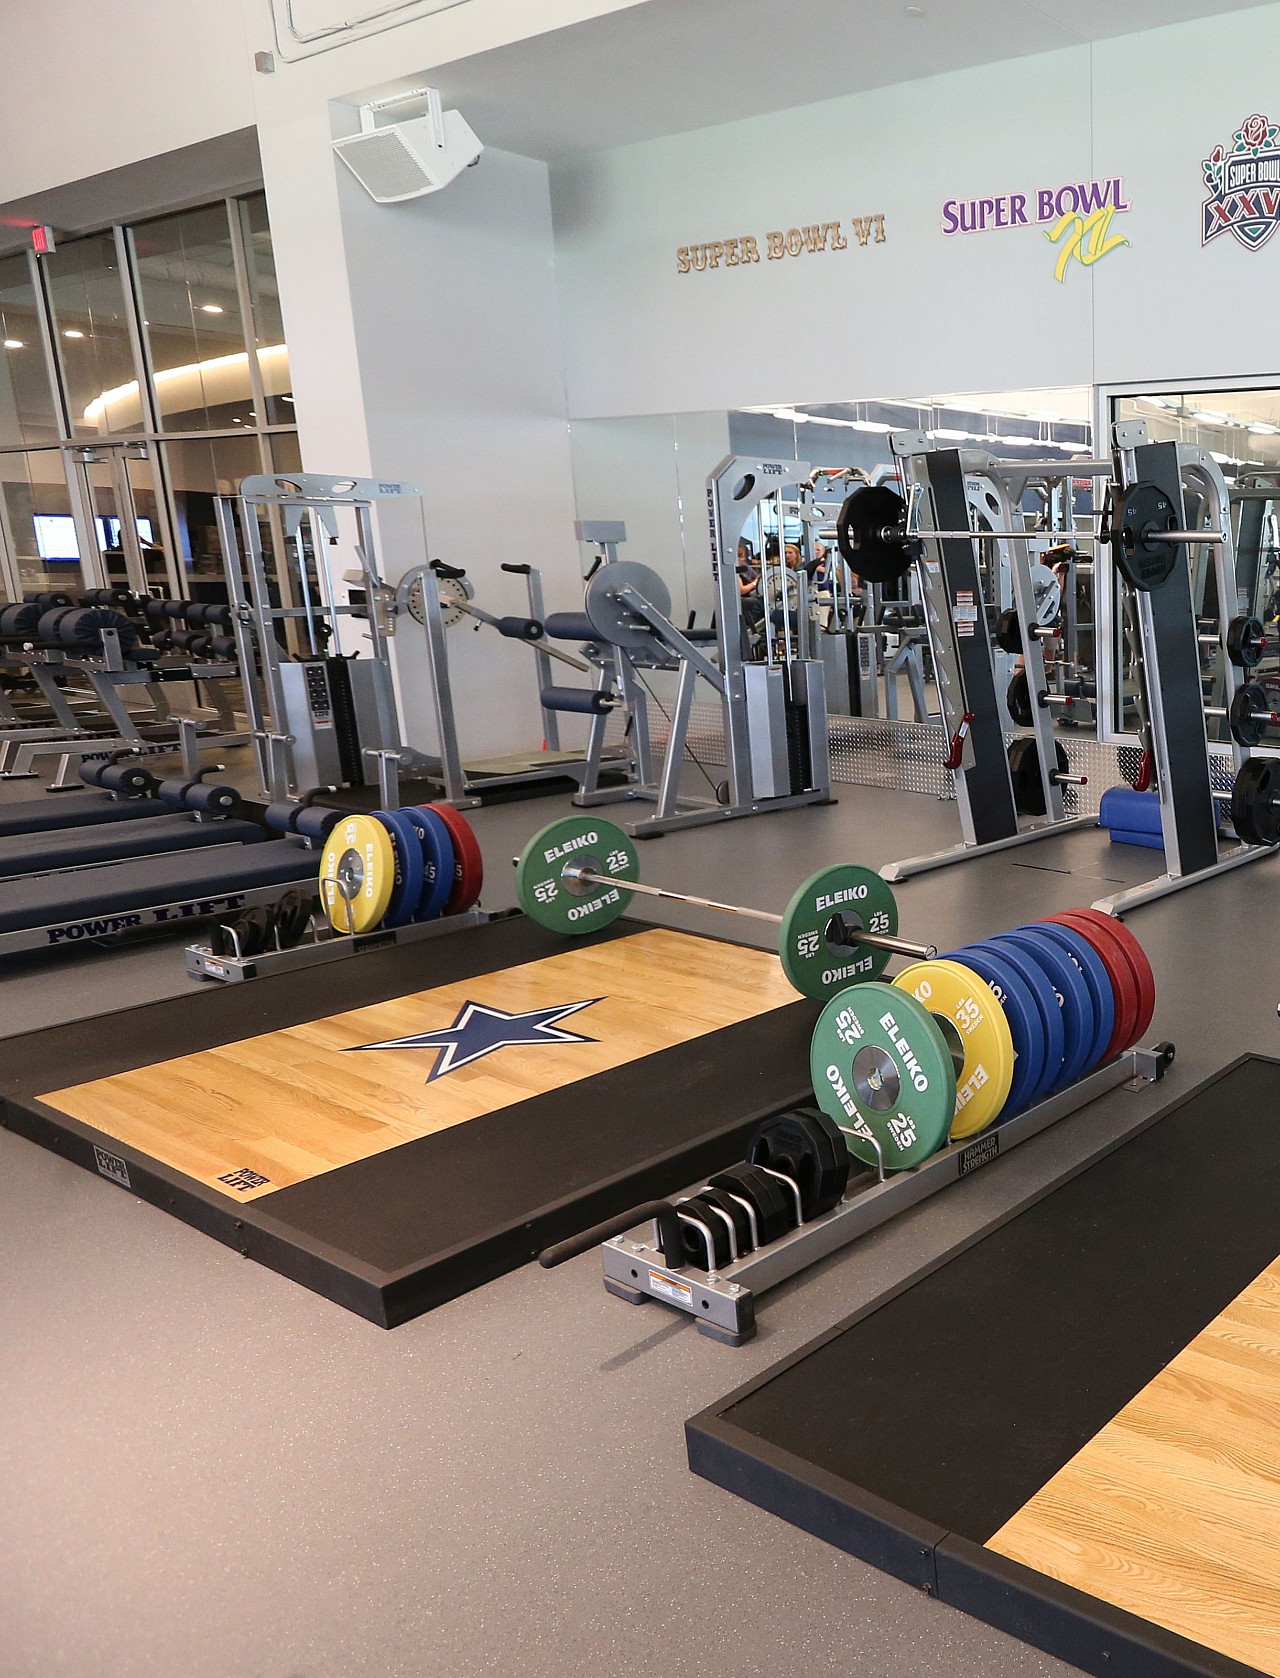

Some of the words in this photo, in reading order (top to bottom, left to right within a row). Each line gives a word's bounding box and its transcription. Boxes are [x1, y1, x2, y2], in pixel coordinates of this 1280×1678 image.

[1230, 163, 1257, 188] SUPER
[942, 193, 1029, 235] SUPER
[1036, 177, 1131, 222] BOWL
[677, 235, 760, 274] SUPER
[766, 221, 847, 260] BOWL
[852, 213, 886, 246] VI
[711, 543, 720, 582] LIFT
[544, 832, 598, 864] ELEIKO
[606, 851, 628, 871] 25
[365, 843, 374, 898] ELEIKO
[534, 882, 559, 903] 25
[567, 888, 620, 921] ELEIKO
[815, 885, 868, 912] ELEIKO
[47, 914, 144, 944] POWER
[152, 895, 246, 923] LIFT
[869, 914, 890, 933] 25
[797, 935, 820, 956] 25
[821, 956, 873, 985] ELEIKO
[835, 1009, 863, 1046] 25
[955, 998, 981, 1029] 35
[879, 1011, 929, 1093] ELEIKO
[889, 1112, 918, 1149] 25
[962, 1144, 998, 1173] STRENGTH
[964, 1137, 996, 1163] HAMMER
[217, 1173, 257, 1192] LIFT
[233, 1168, 271, 1187] POWER
